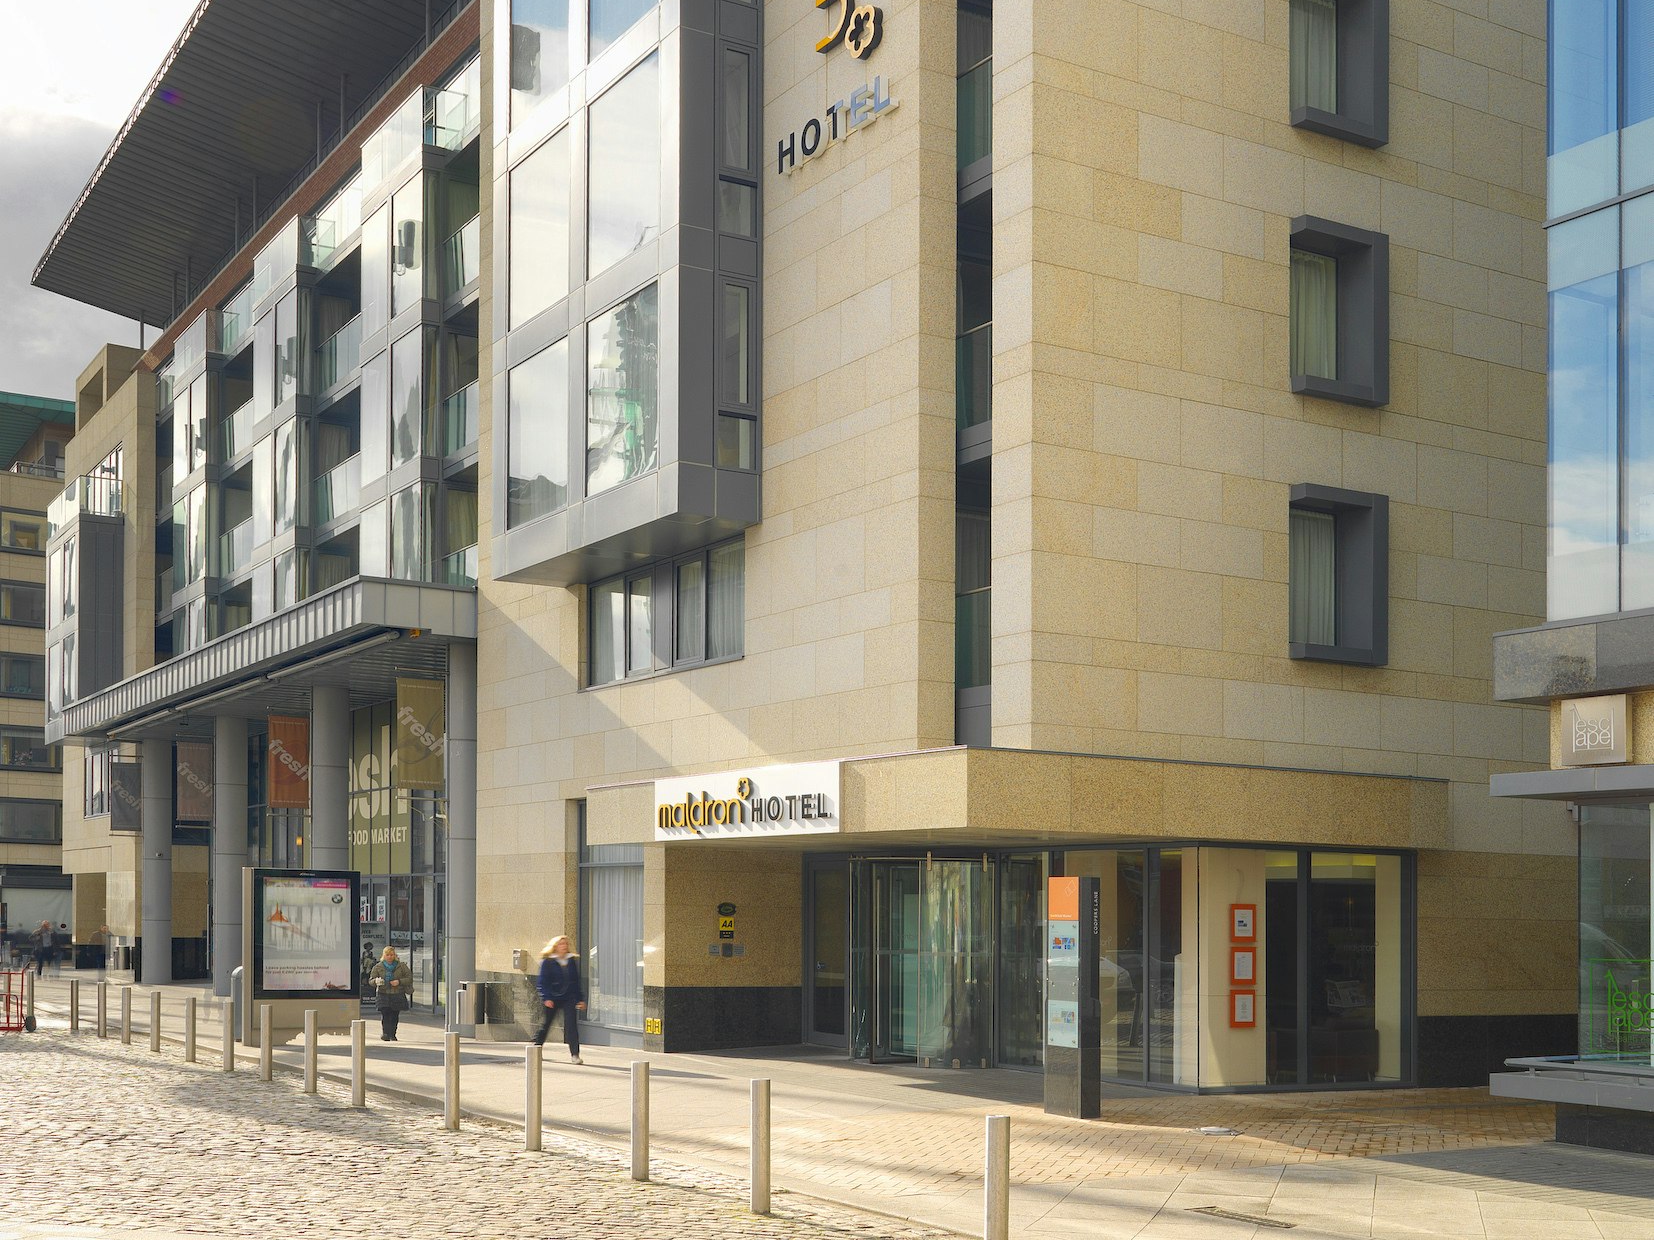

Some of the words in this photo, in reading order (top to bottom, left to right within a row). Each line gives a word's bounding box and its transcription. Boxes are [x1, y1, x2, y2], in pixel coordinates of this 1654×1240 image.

[778, 75, 898, 175] HOTEL
[398, 705, 445, 758] fresh
[269, 739, 309, 781] fresh
[112, 780, 142, 810] fresh
[177, 762, 213, 798] fresh
[658, 791, 744, 834] maldron
[751, 793, 832, 823] HOTEL
[371, 826, 408, 845] MARKET
[721, 920, 733, 928] AA
